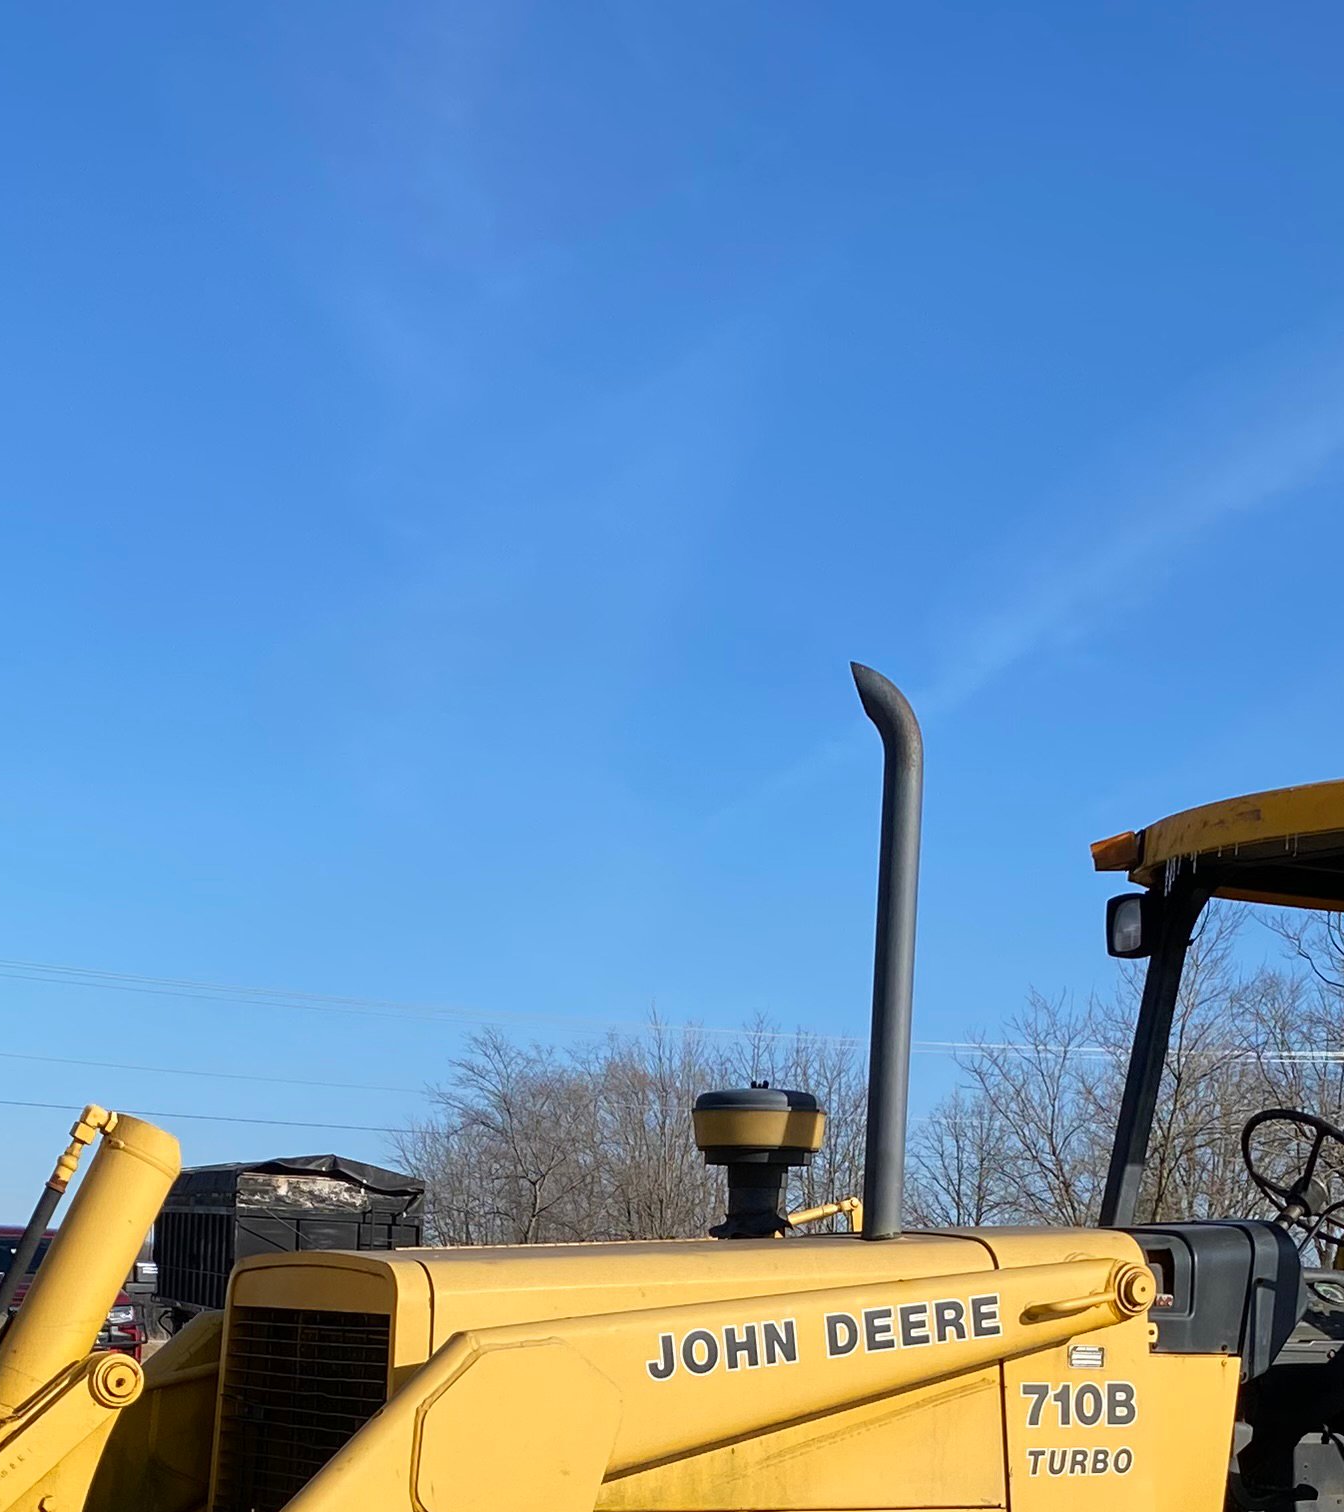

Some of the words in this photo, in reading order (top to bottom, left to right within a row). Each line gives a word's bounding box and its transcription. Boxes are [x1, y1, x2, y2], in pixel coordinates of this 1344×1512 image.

[647, 1319, 799, 1381] JOHN
[825, 1294, 1003, 1359] DEERE
[1022, 1382, 1137, 1428] 710B
[1027, 1447, 1135, 1476] TURBO
